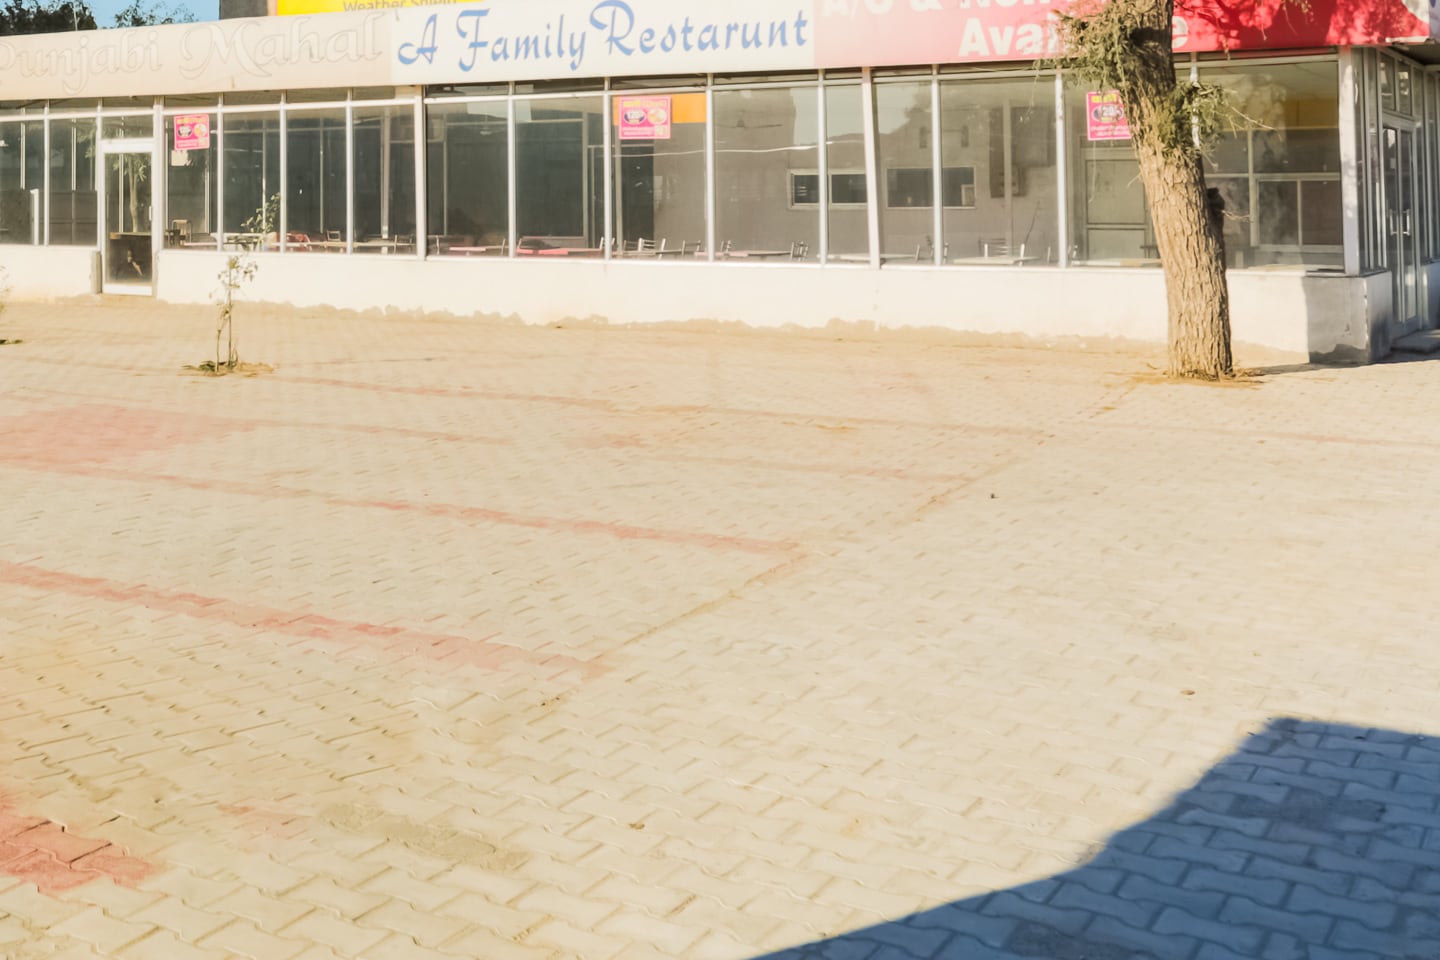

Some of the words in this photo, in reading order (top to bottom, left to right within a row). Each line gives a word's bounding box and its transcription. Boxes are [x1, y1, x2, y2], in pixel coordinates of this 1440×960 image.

[178, 12, 385, 79] Mahal
[398, 13, 438, 66] A
[456, 7, 587, 72] Family
